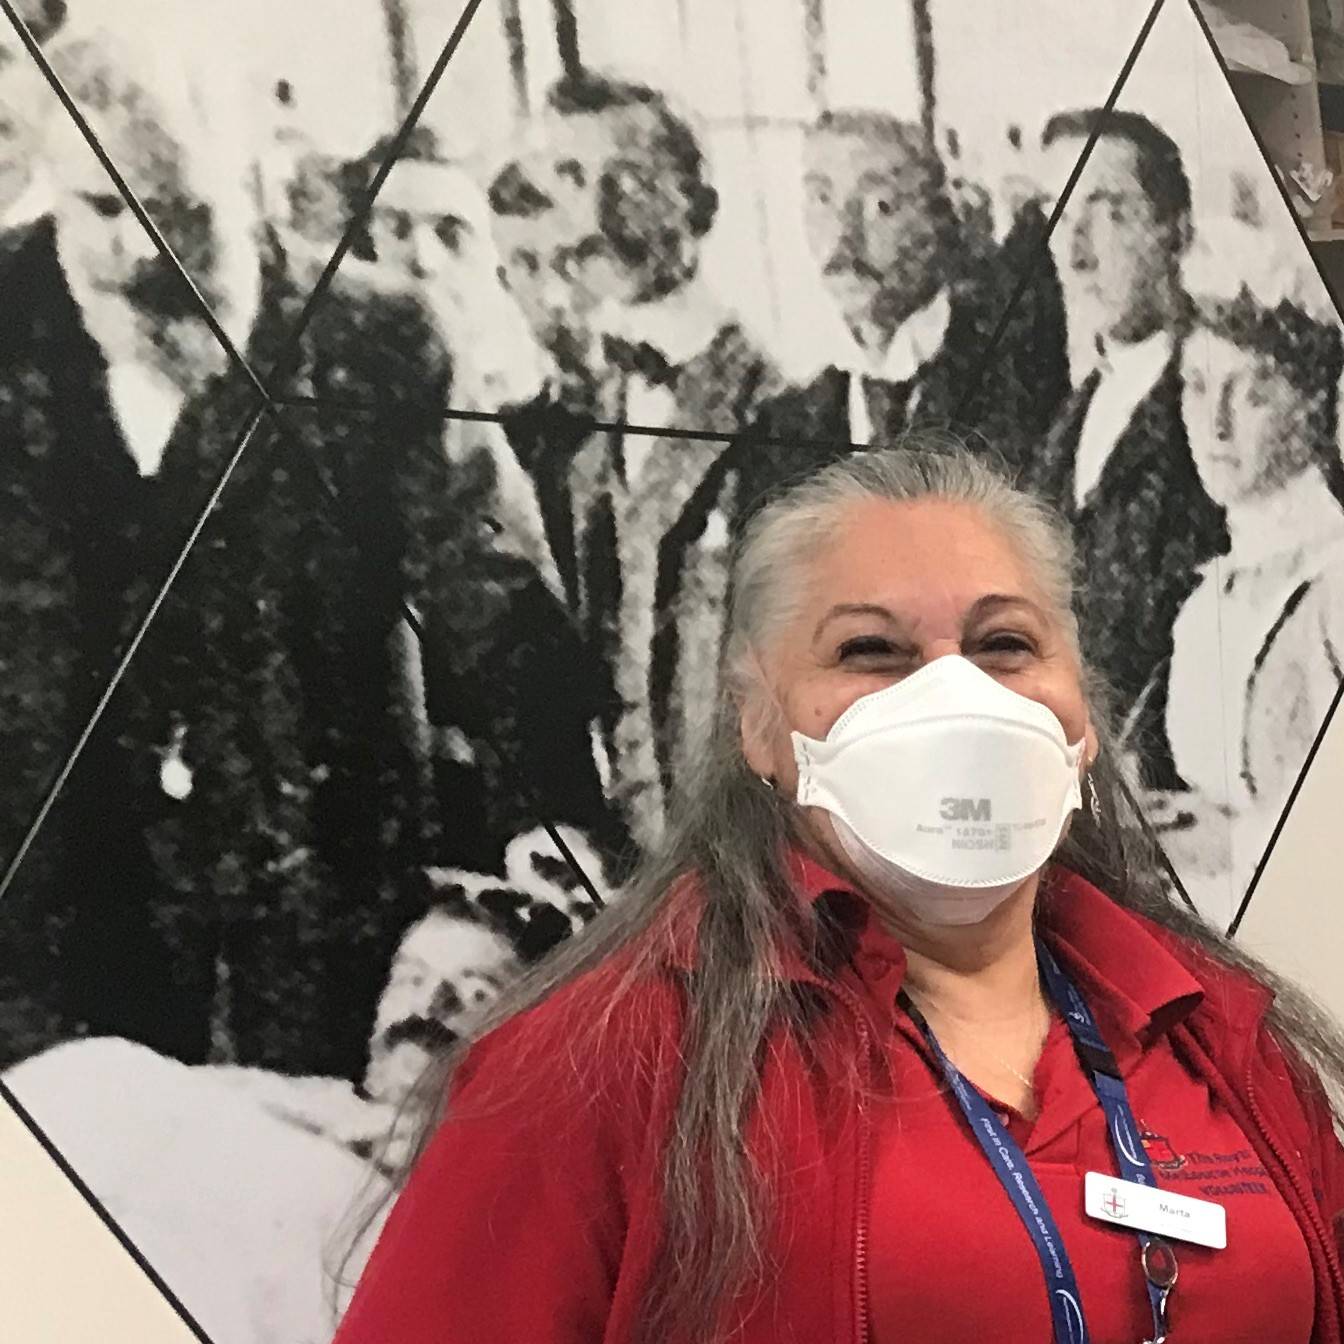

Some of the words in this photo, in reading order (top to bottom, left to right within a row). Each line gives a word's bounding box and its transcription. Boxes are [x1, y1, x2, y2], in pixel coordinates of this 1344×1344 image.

[939, 797, 992, 821] 3M
[1159, 1203, 1191, 1219] Marta
[1035, 1216, 1049, 1235] and
